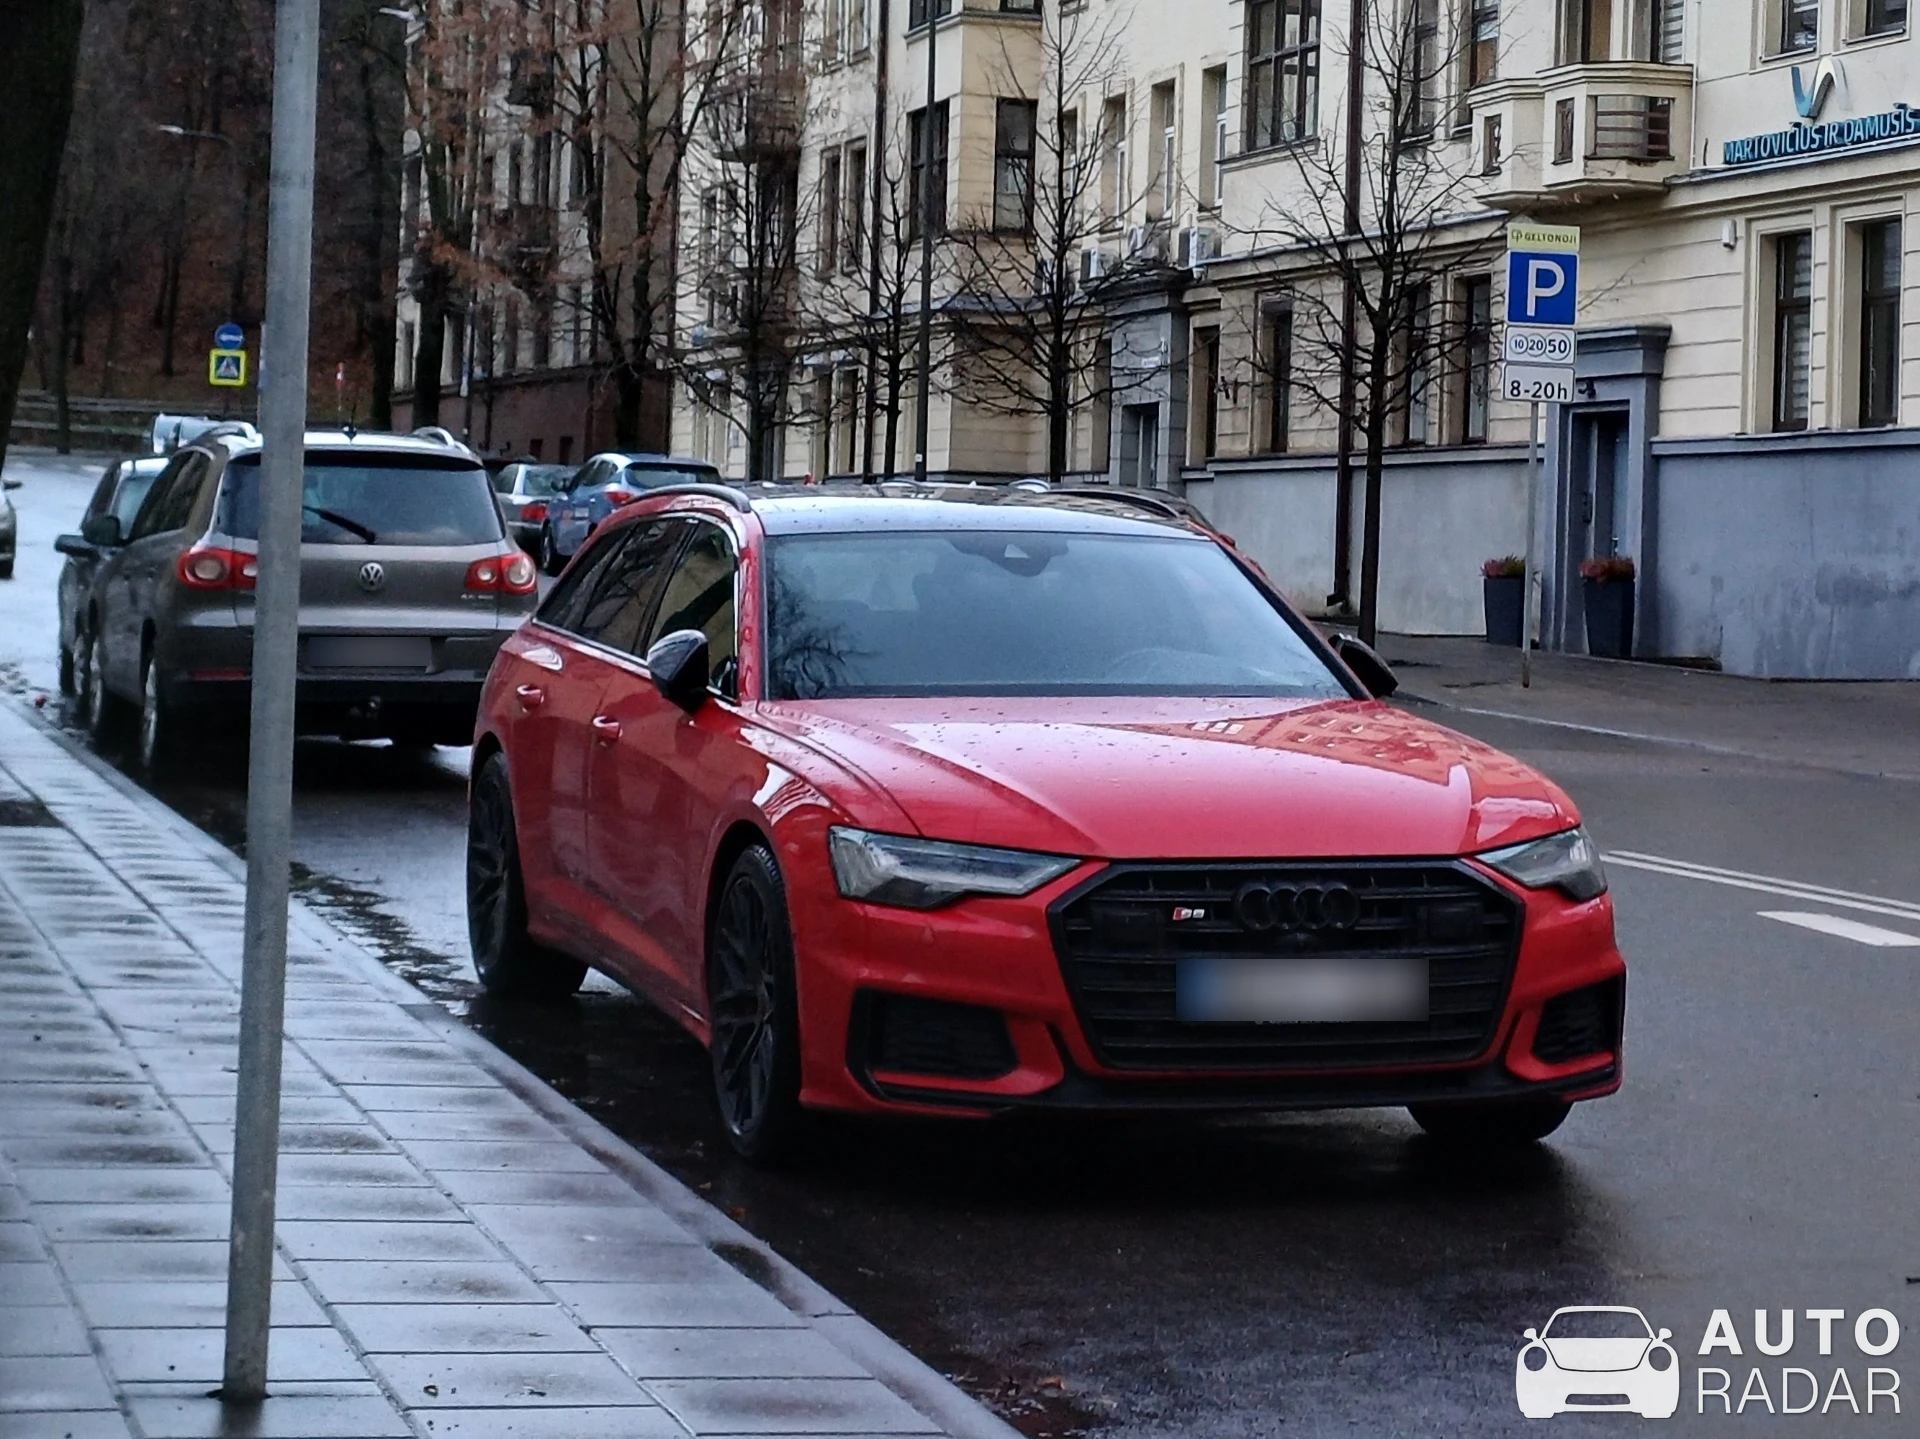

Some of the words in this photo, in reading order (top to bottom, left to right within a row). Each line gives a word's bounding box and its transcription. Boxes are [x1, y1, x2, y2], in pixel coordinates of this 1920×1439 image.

[1526, 259, 1565, 317] P
[1514, 338, 1525, 350] 10
[1528, 339, 1544, 351] 20
[1547, 339, 1567, 354] 50
